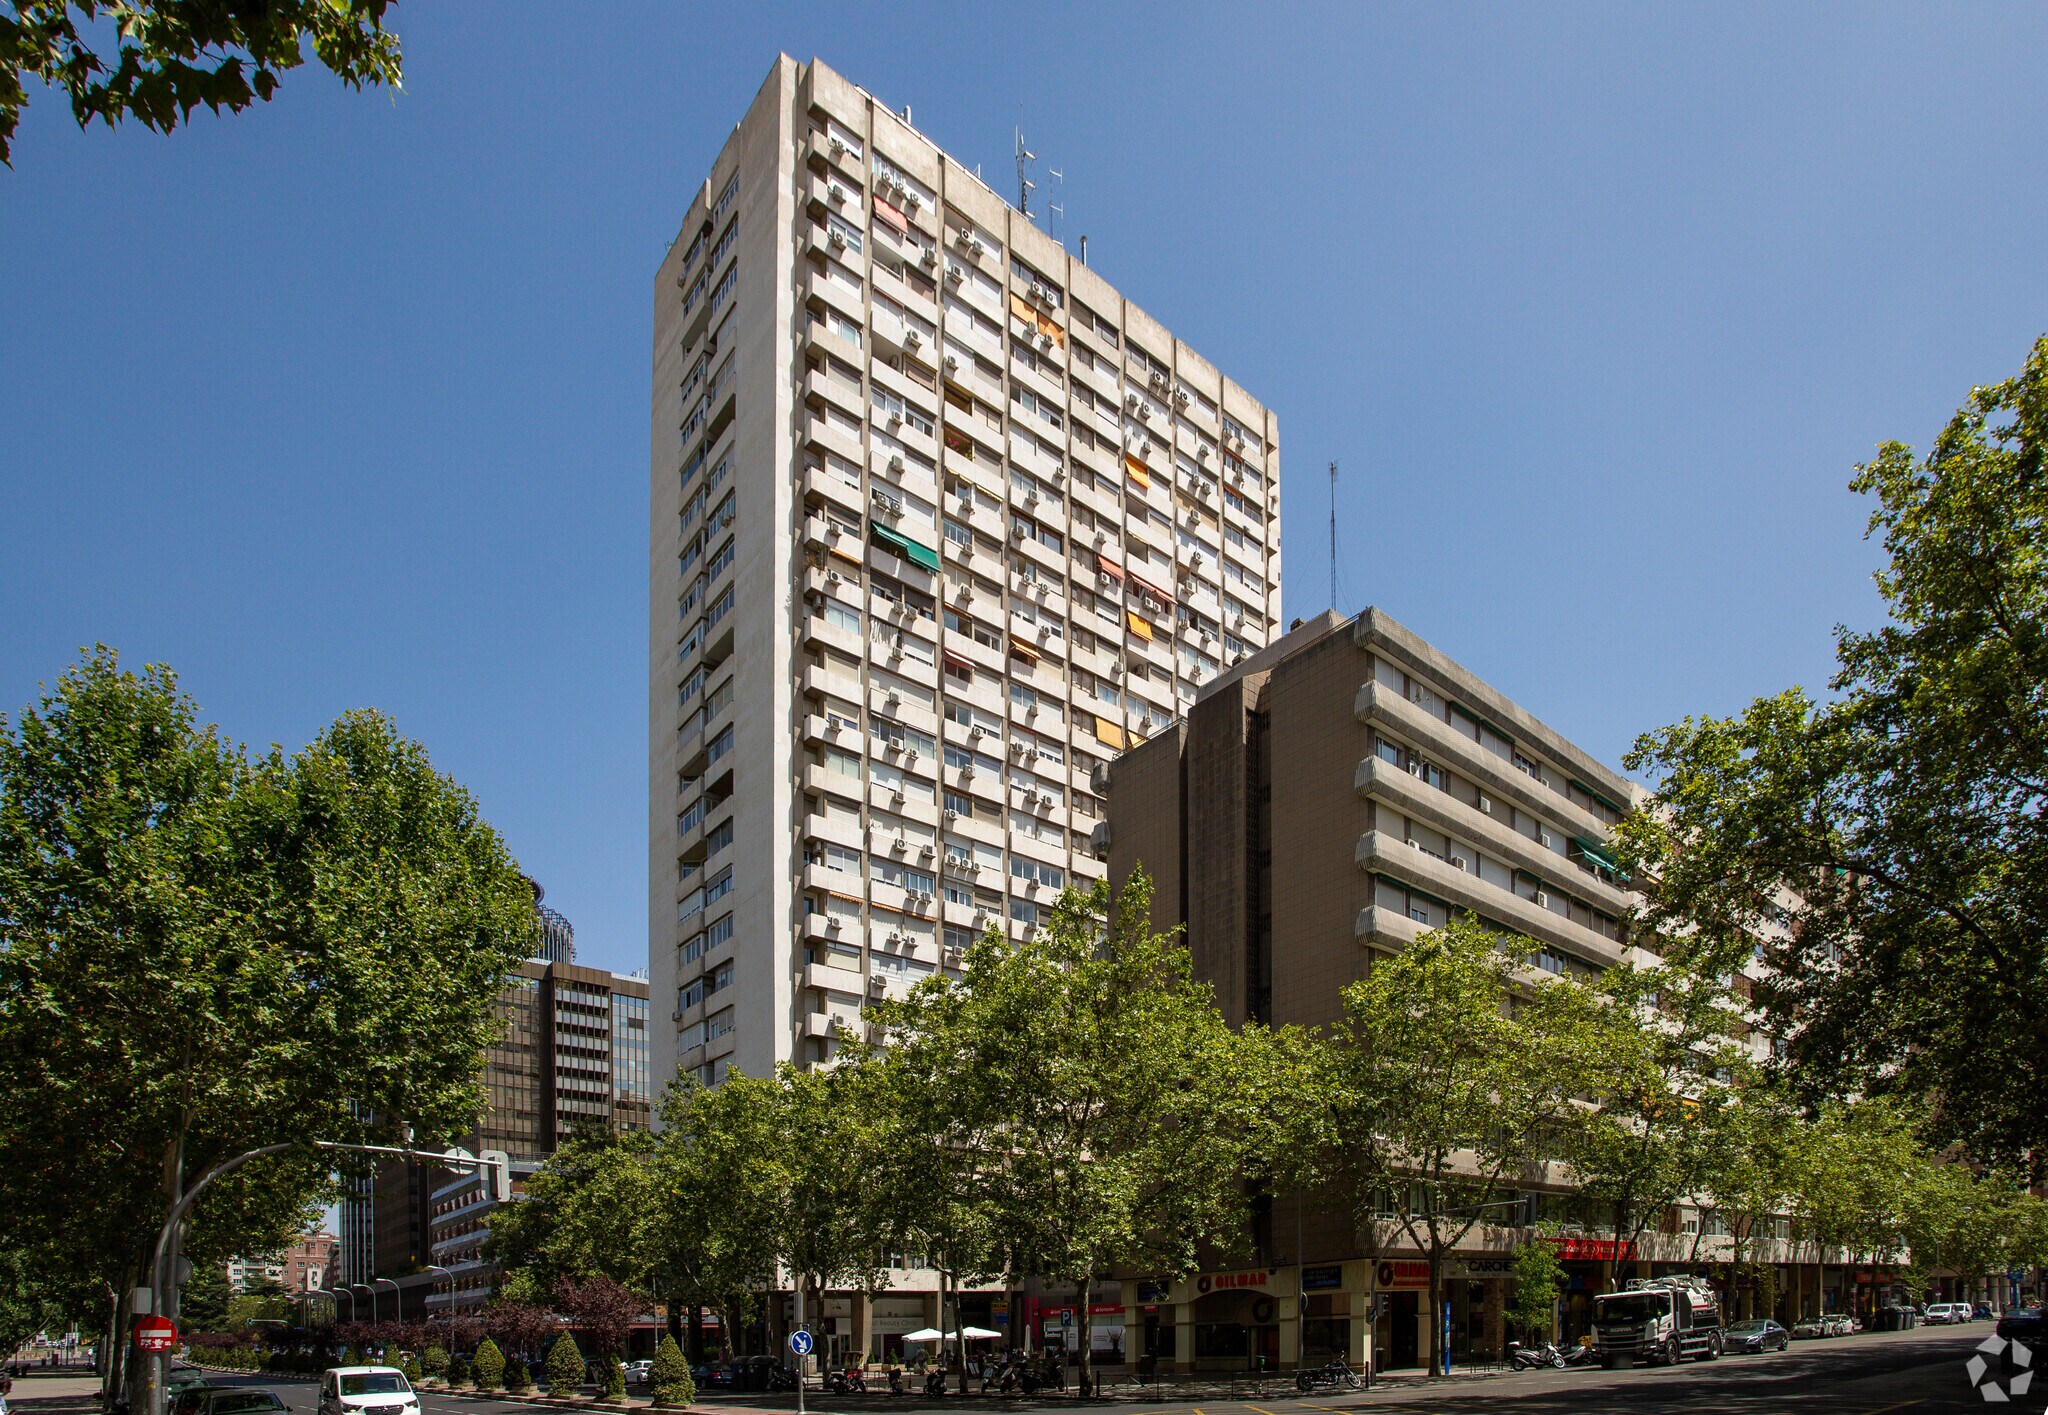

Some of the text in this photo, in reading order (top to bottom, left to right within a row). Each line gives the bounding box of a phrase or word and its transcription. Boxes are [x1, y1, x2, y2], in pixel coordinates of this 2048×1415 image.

[1469, 1260, 1512, 1272] CARCHE
[1215, 1272, 1267, 1288] GILMAR
[880, 1320, 900, 1328] Beauty
[1062, 1311, 1070, 1325] P
